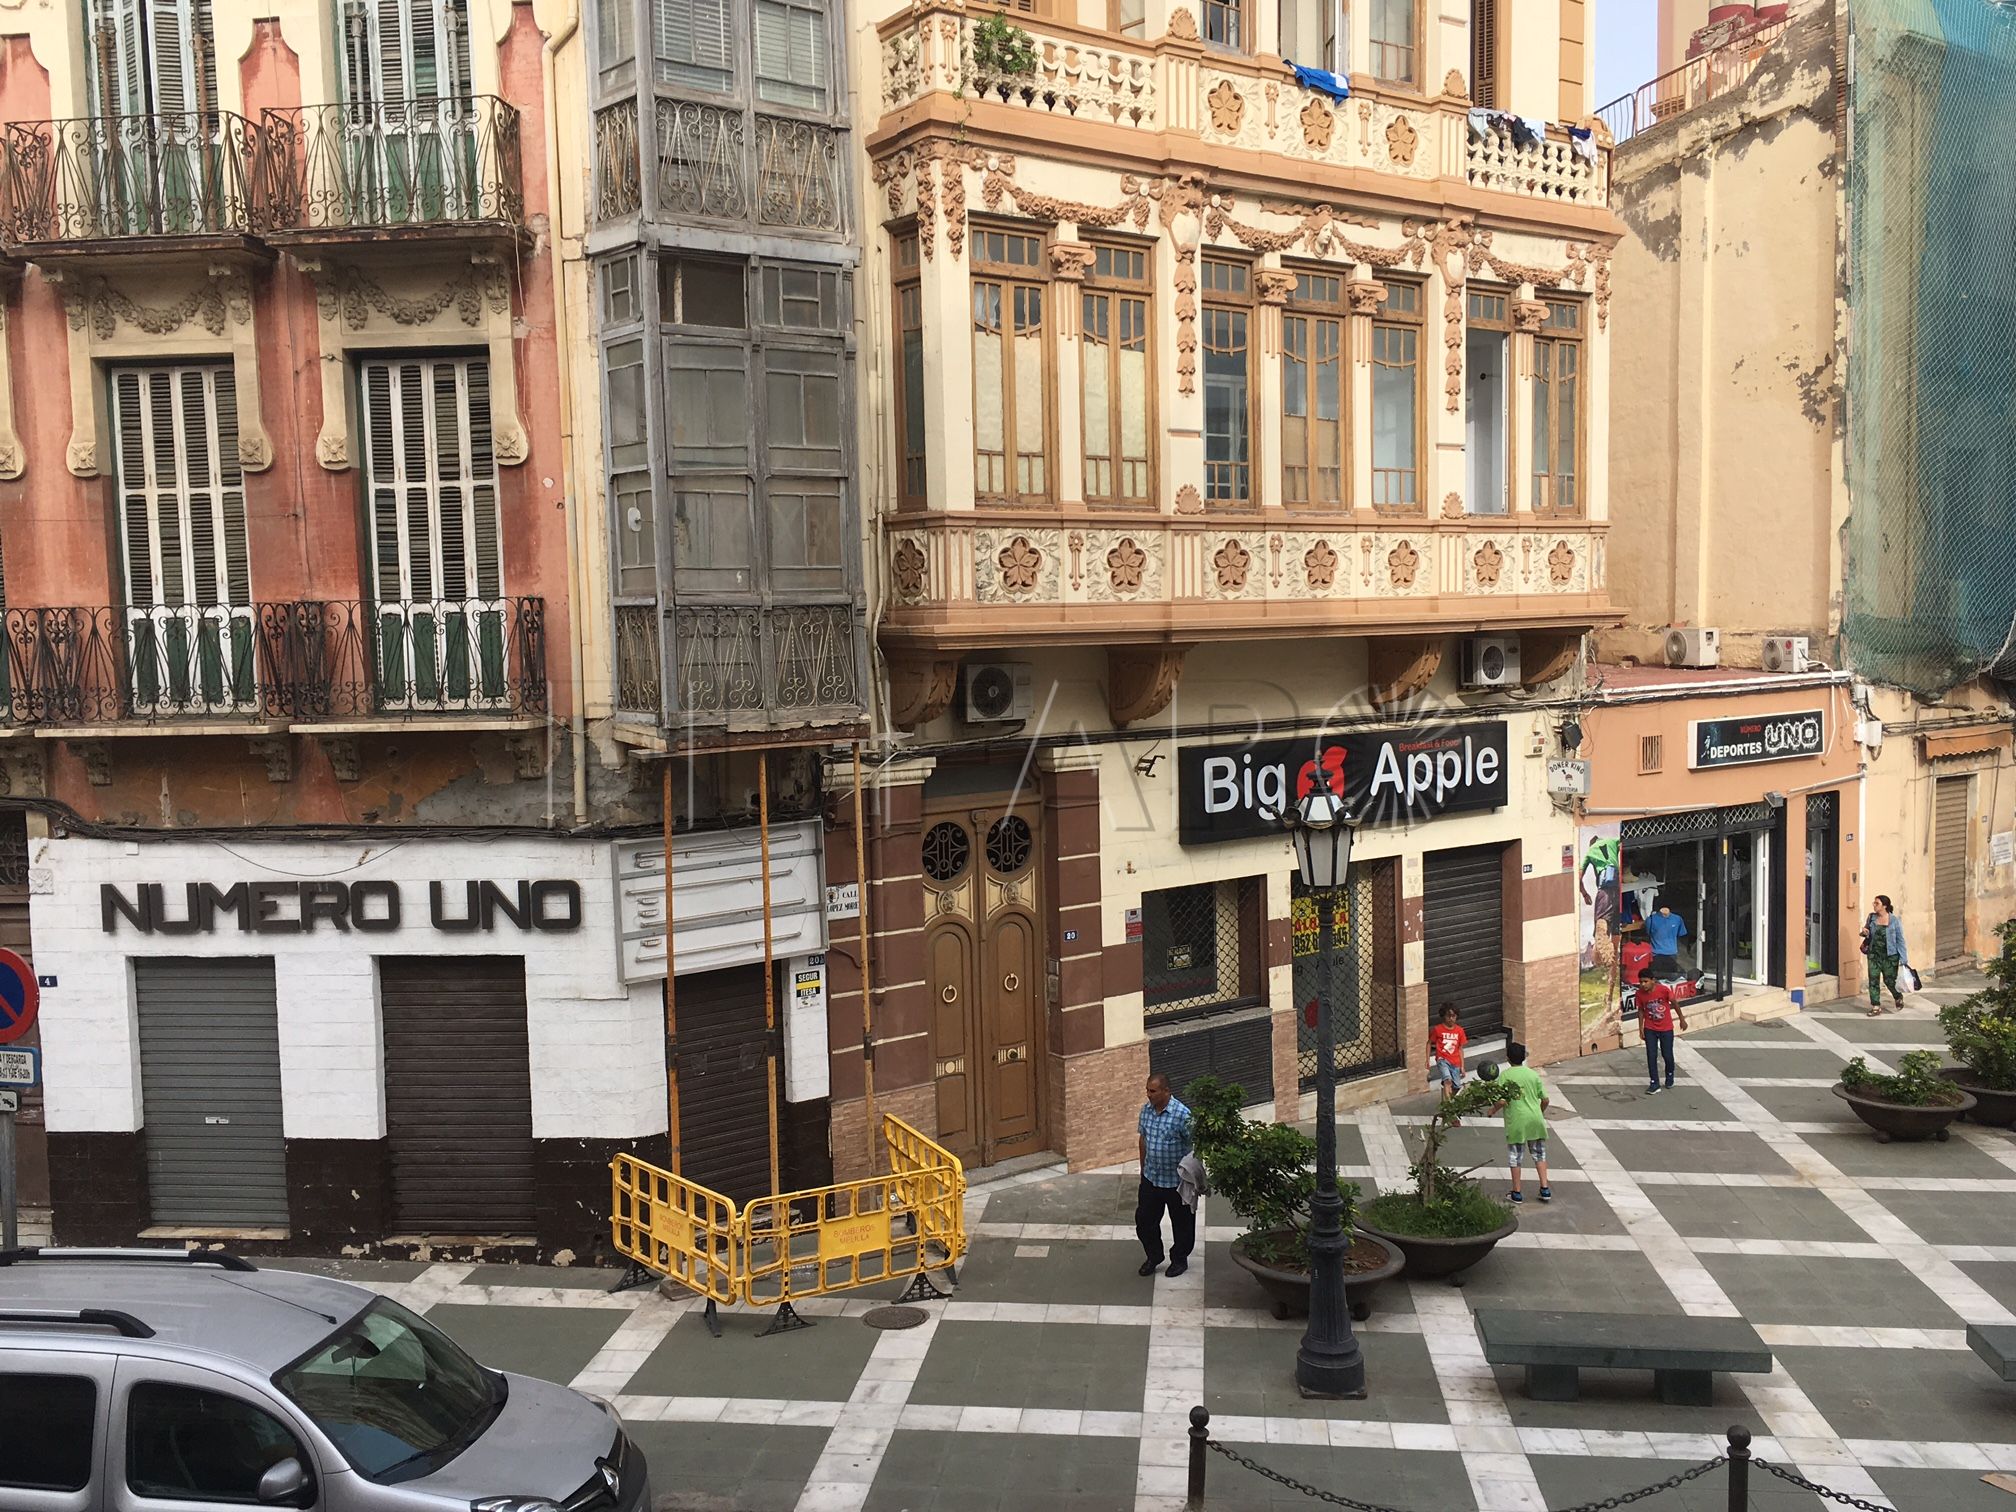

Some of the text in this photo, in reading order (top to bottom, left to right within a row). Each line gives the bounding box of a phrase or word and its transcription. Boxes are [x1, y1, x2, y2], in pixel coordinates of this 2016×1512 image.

[1764, 718, 1819, 754] UNO
[1399, 741, 1433, 752] Breakfast
[1710, 742, 1762, 759] DEPORTES
[1203, 753, 1286, 820] Big
[1370, 735, 1499, 806] Apple
[842, 890, 857, 898] CALL
[100, 880, 582, 934] NUMERO UNO
[844, 901, 858, 910] MORE
[1066, 932, 1076, 940] 20
[44, 977, 50, 986] 4
[798, 972, 818, 982] SEGUR
[1442, 1032, 1459, 1040] TEAM
[833, 1223, 876, 1238] BOMBEROS
